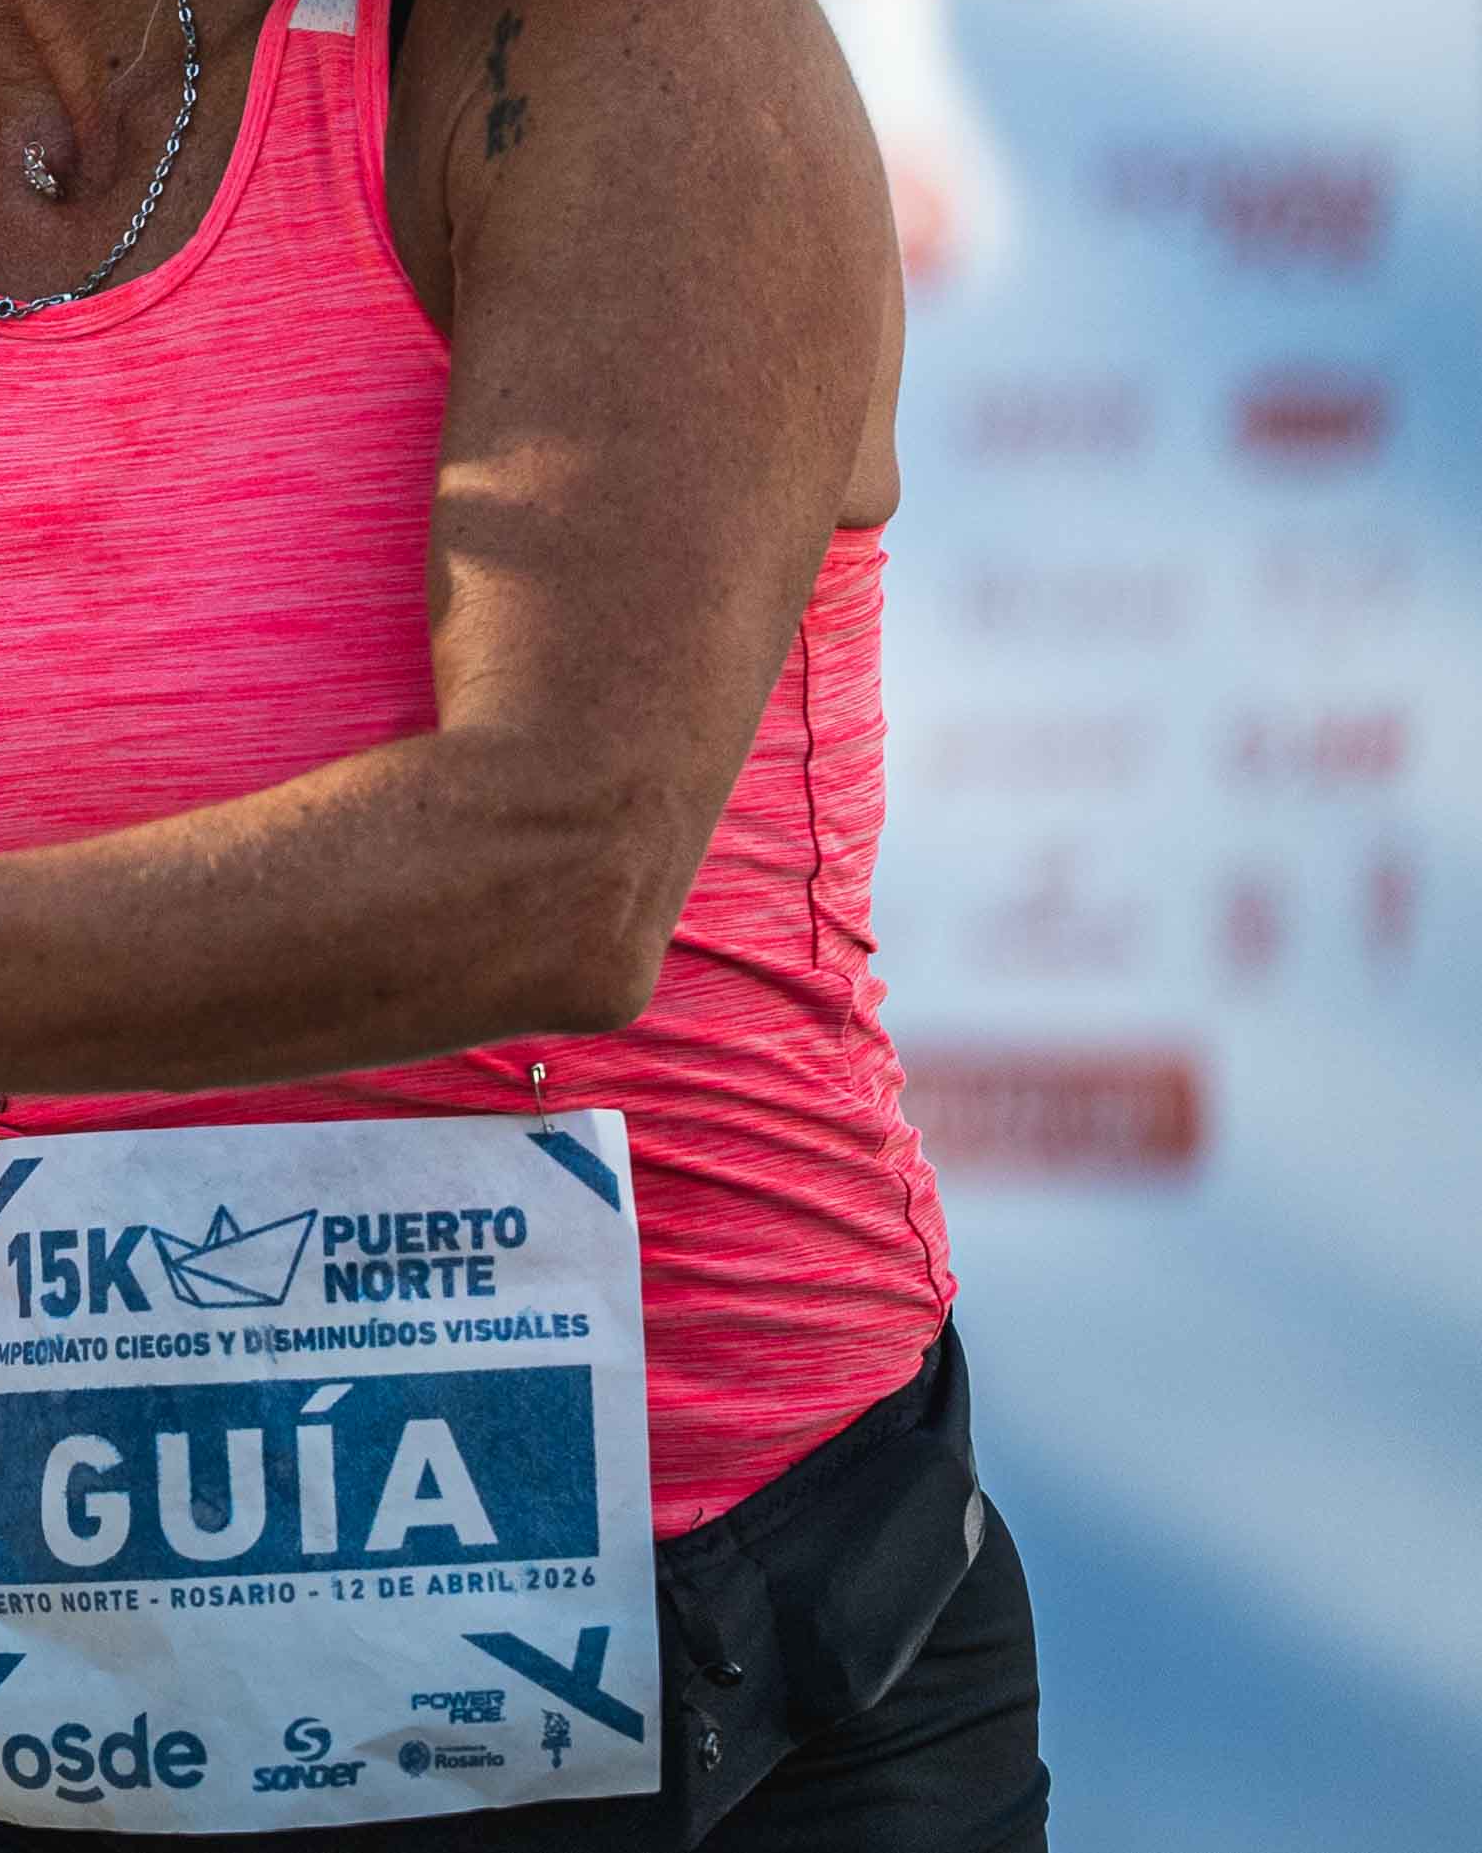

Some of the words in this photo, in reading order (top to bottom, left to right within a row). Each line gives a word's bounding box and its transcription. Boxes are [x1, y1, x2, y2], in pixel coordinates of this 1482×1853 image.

[321, 1206, 529, 1257] PUERTO
[6, 1224, 154, 1320] 15K
[323, 1255, 496, 1304] NORTE
[115, 1331, 212, 1359] CIEGOS
[217, 1331, 237, 1356] Y
[443, 1313, 591, 1344] VISUALES
[40, 1382, 500, 1567] GUÍA
[60, 1589, 140, 1613] NORTE
[170, 1581, 296, 1609] ROSARIO
[332, 1577, 365, 1601] 12
[378, 1575, 415, 1599] DE
[426, 1569, 514, 1596] ABRIL
[525, 1566, 597, 1591] 2026
[411, 1689, 506, 1711] POWER
[1, 1711, 208, 1803] osde
[435, 1751, 505, 1771] Rosario
